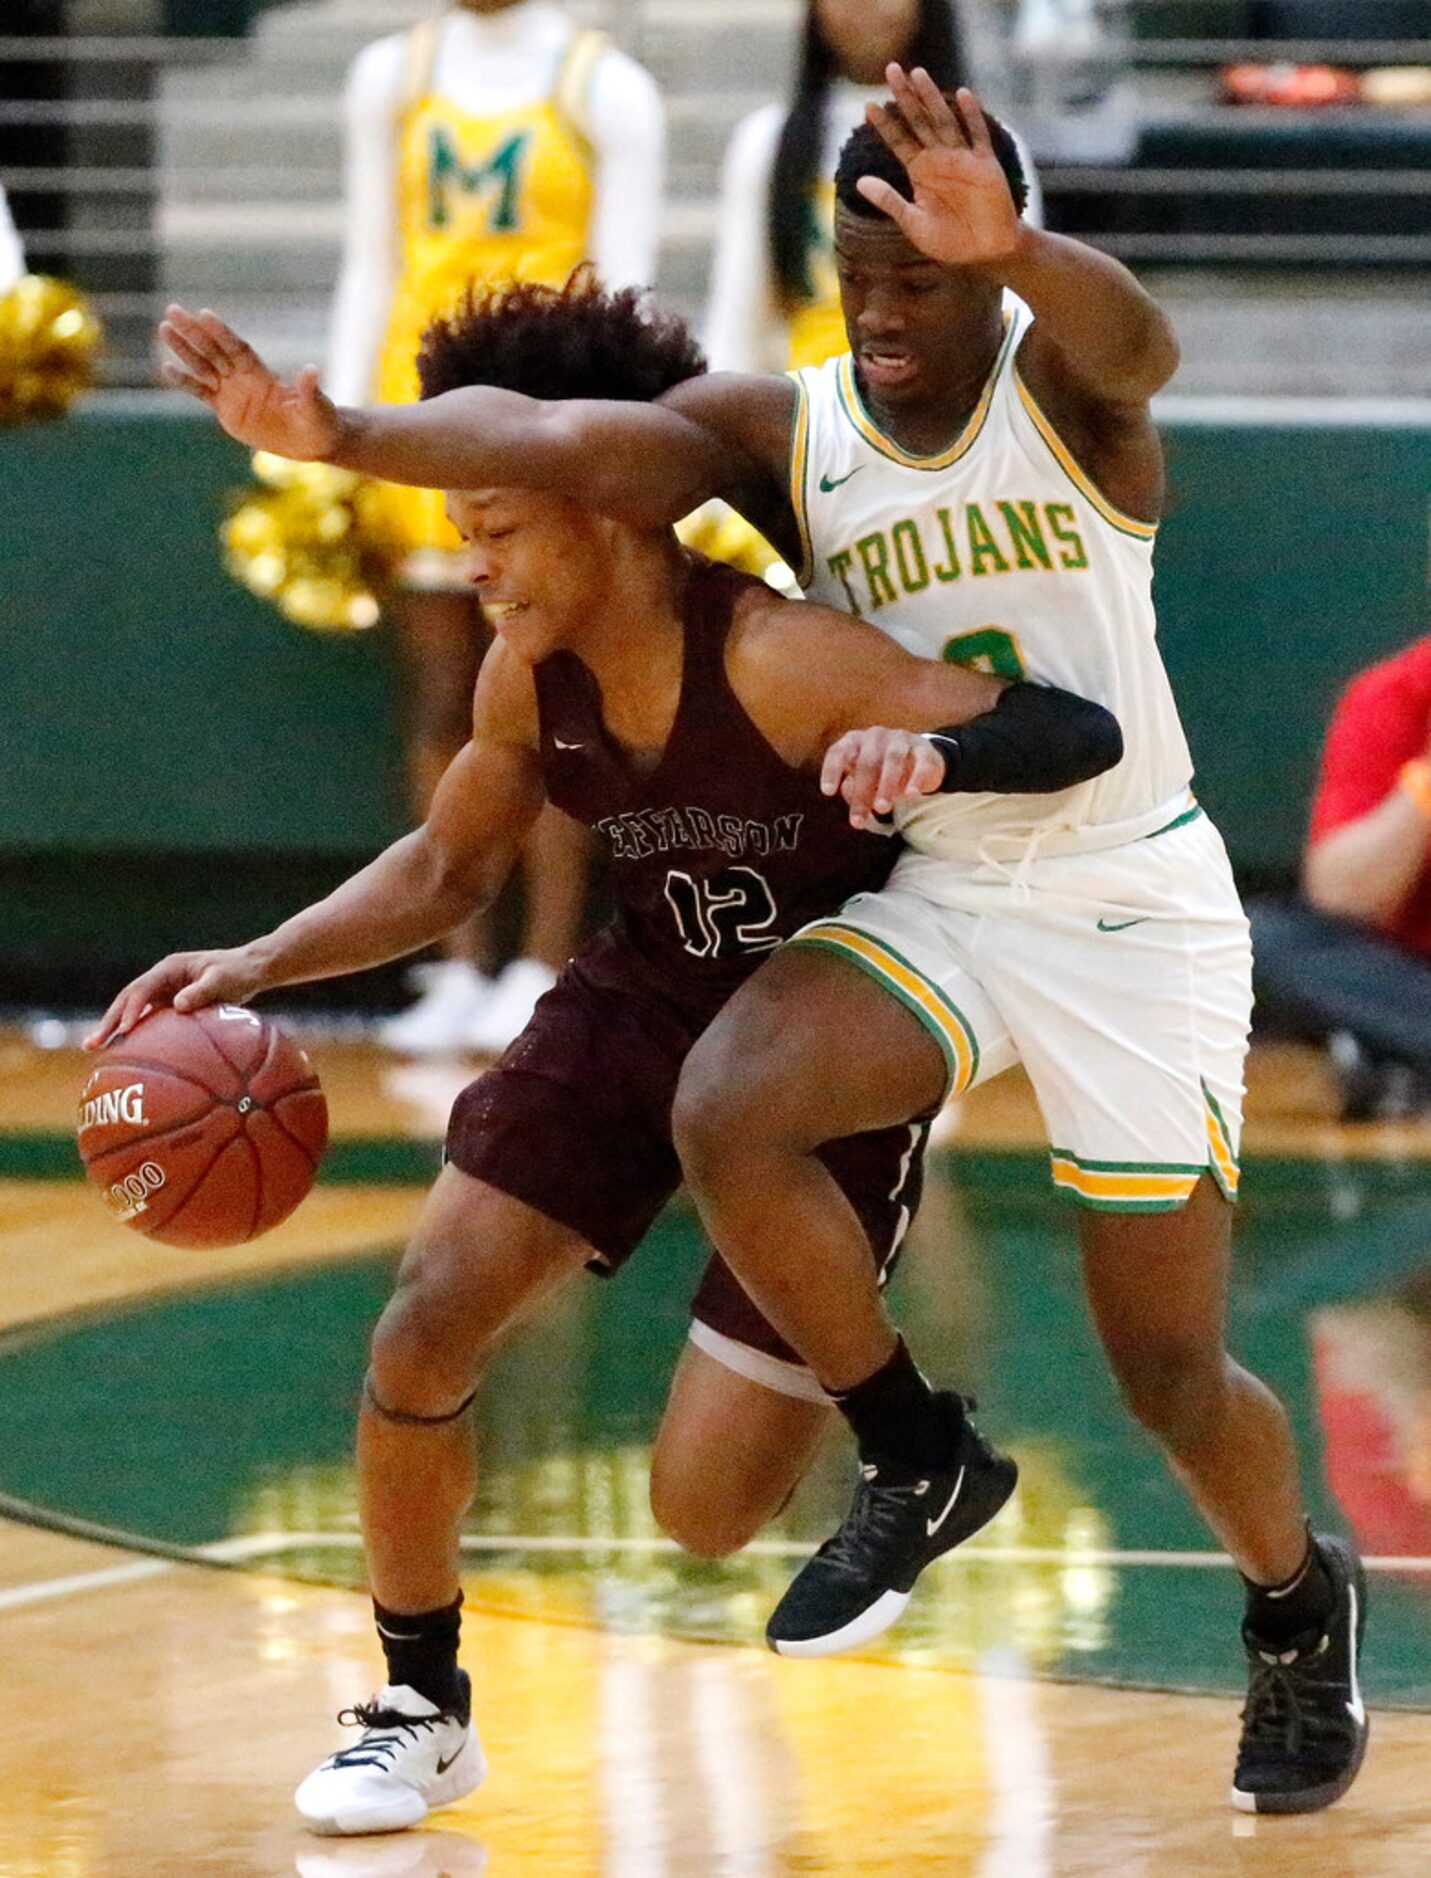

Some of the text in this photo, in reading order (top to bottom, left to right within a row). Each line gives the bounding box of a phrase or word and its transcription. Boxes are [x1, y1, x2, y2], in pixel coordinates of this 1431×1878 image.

[428, 125, 534, 231] M
[826, 499, 1090, 618] TROJANS
[593, 806, 804, 859] EFFERSON
[664, 866, 783, 958] 12
